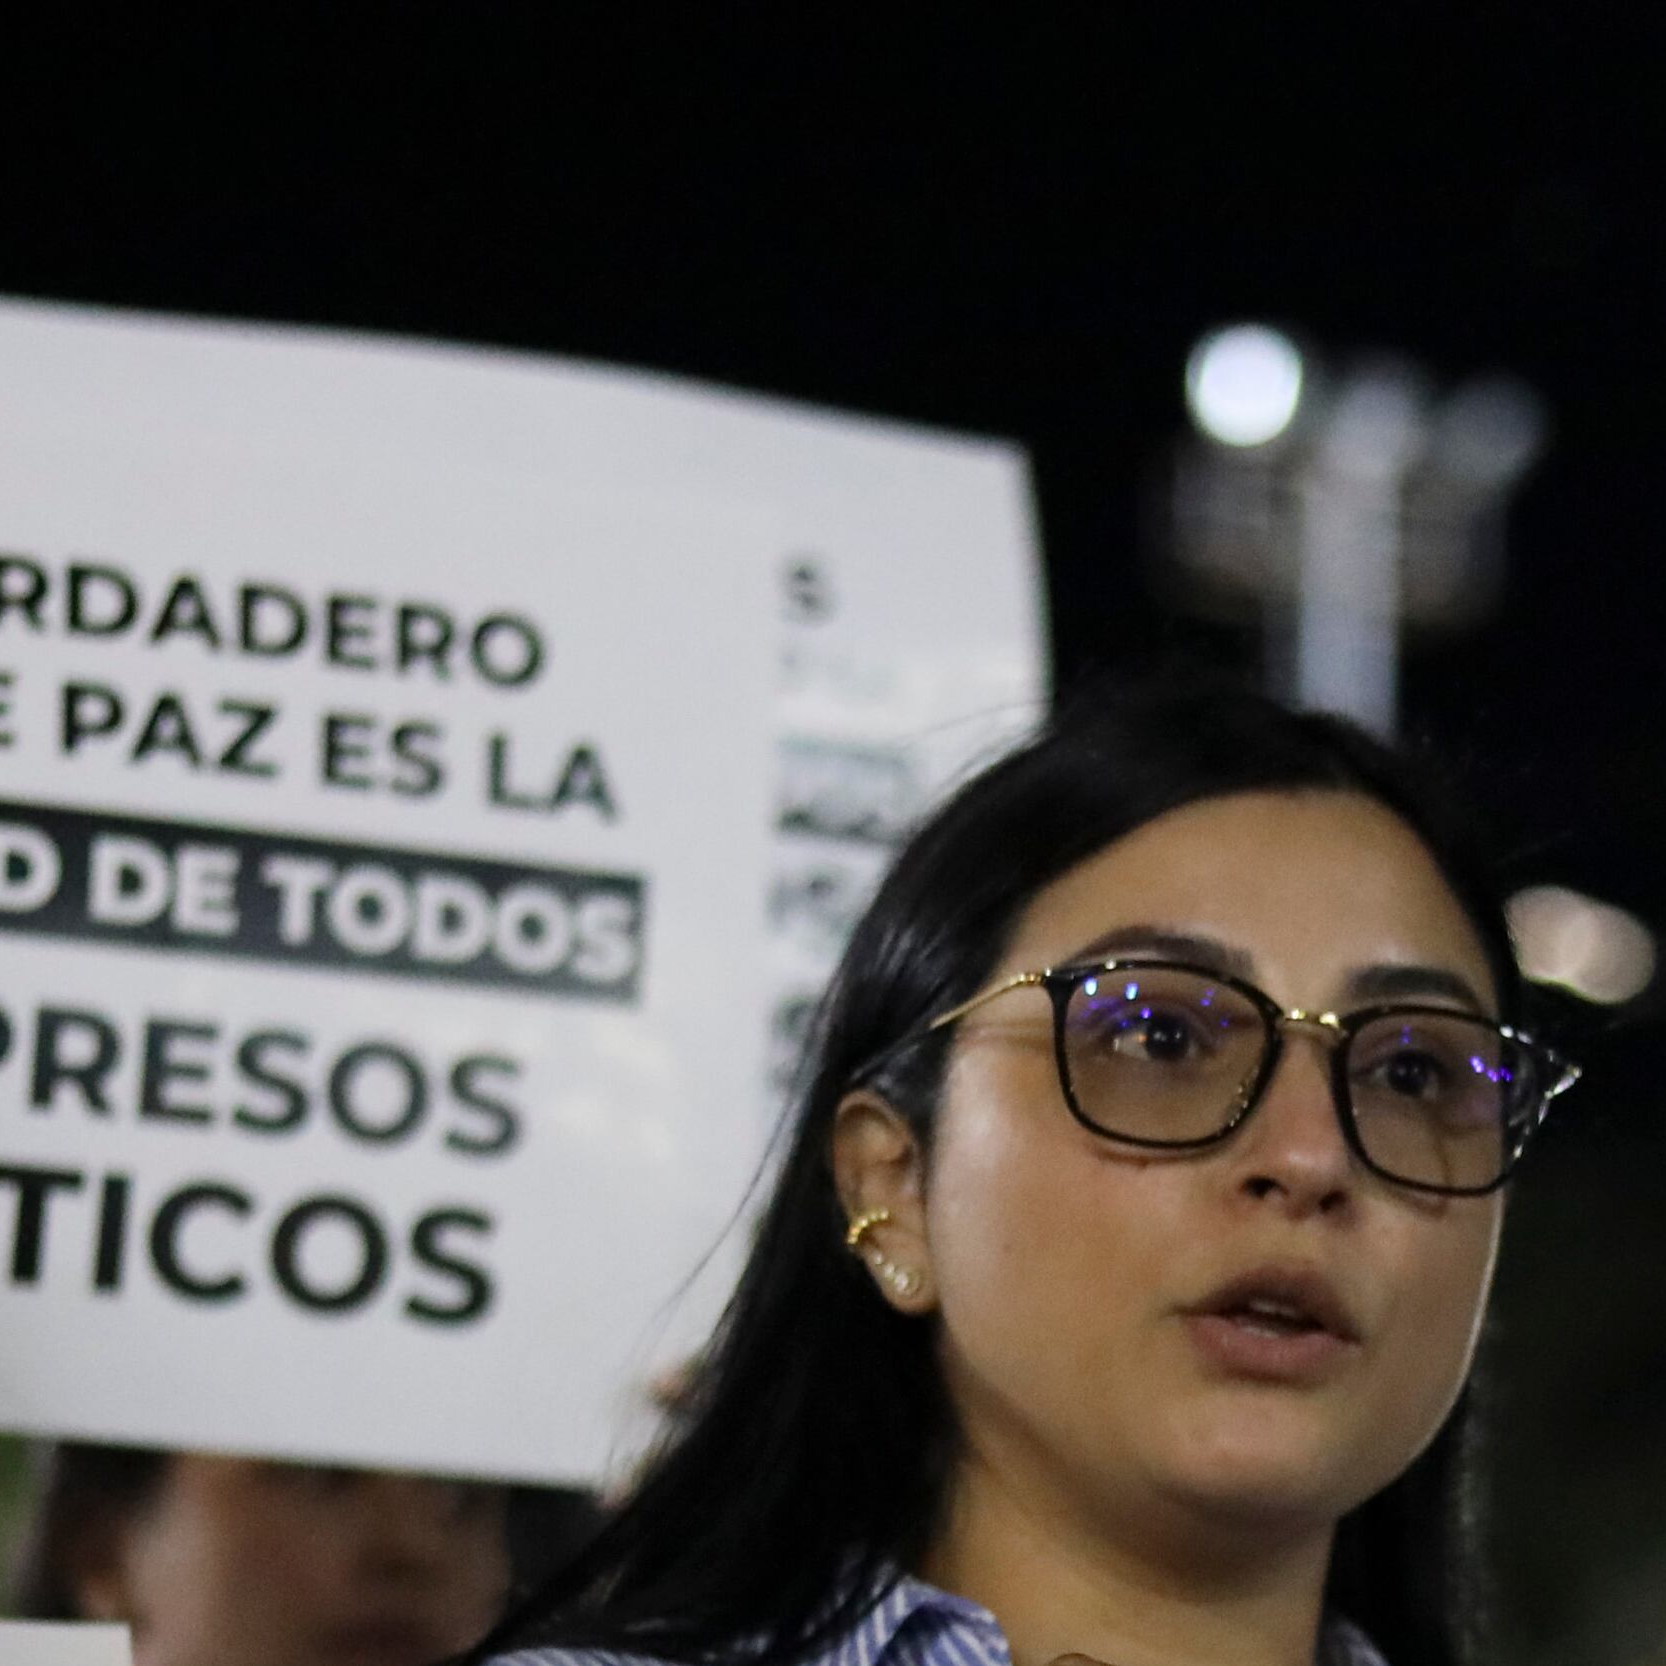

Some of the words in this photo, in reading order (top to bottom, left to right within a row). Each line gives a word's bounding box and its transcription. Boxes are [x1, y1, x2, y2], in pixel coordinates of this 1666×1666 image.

[60, 681, 282, 779] PAZ
[318, 709, 449, 799] ES
[486, 730, 619, 827] LA
[87, 832, 240, 936] DE
[258, 852, 636, 984] TODOS
